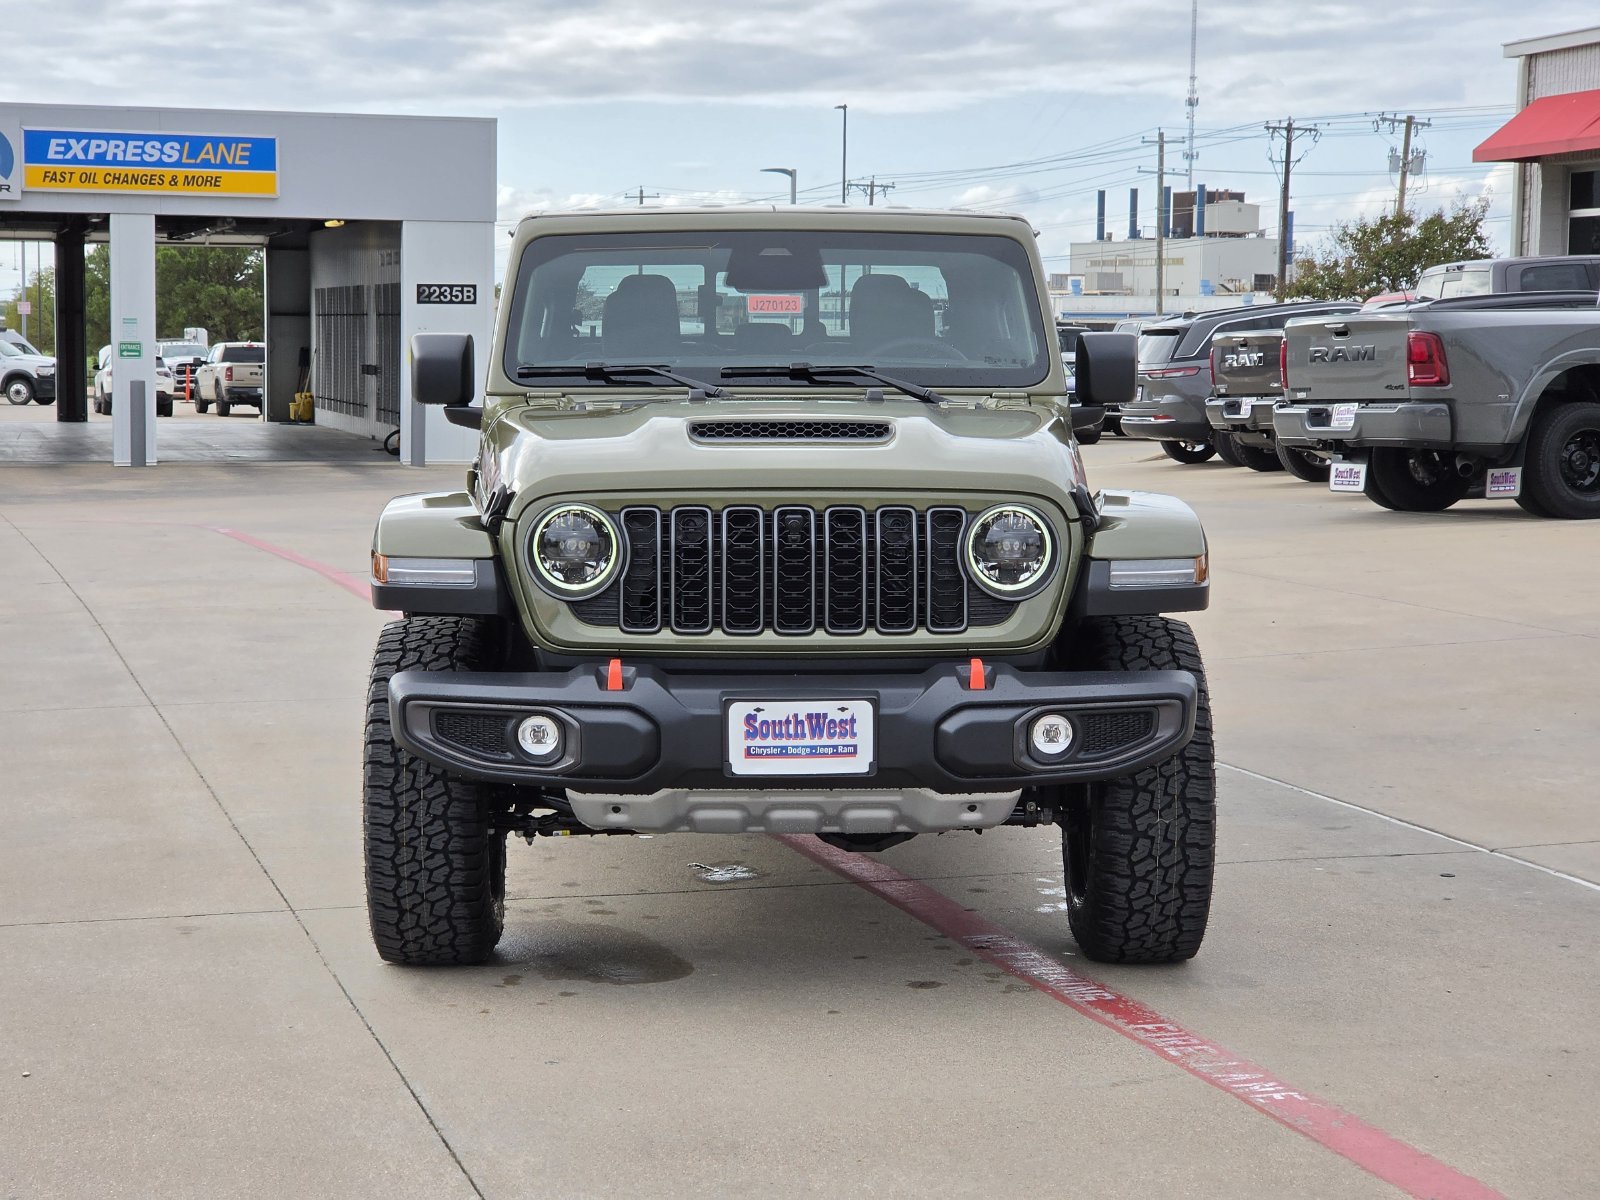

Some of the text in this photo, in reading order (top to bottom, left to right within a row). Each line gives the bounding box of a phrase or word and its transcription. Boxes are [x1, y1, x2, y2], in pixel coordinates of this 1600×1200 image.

[47, 138, 252, 165] EXPRESSLANE
[42, 171, 222, 188] FAST OIL CHANGES & MORE
[419, 286, 475, 302] 2235B
[752, 300, 798, 311] J270123
[120, 343, 141, 351] ENTRANCE
[1309, 344, 1376, 363] RAM
[1224, 352, 1264, 367] RAM
[743, 712, 858, 741] SouthWest
[750, 745, 854, 755] Chrysler Dodge Jeep Ram
